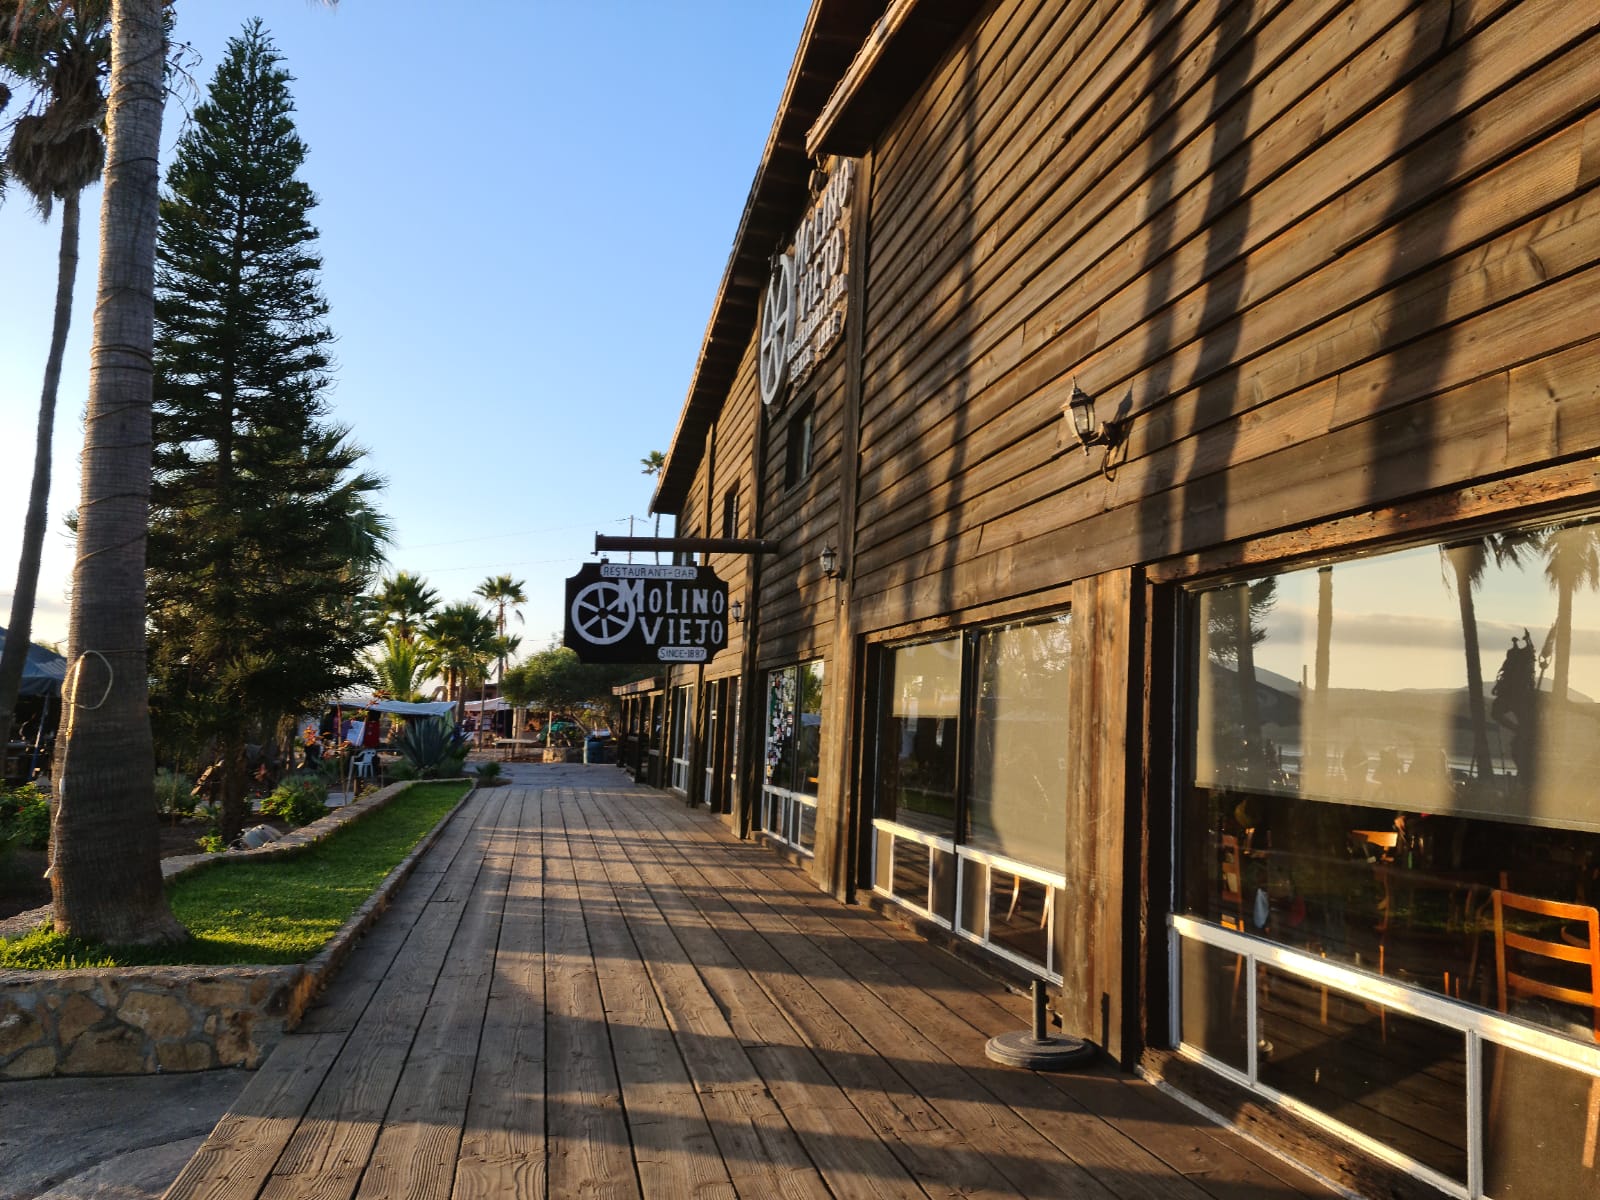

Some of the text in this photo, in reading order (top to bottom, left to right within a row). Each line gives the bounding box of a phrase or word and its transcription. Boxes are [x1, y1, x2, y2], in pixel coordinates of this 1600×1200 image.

[800, 228, 844, 321] VIEJO
[617, 578, 725, 615] MOLINO
[638, 616, 724, 645] VIEJO
